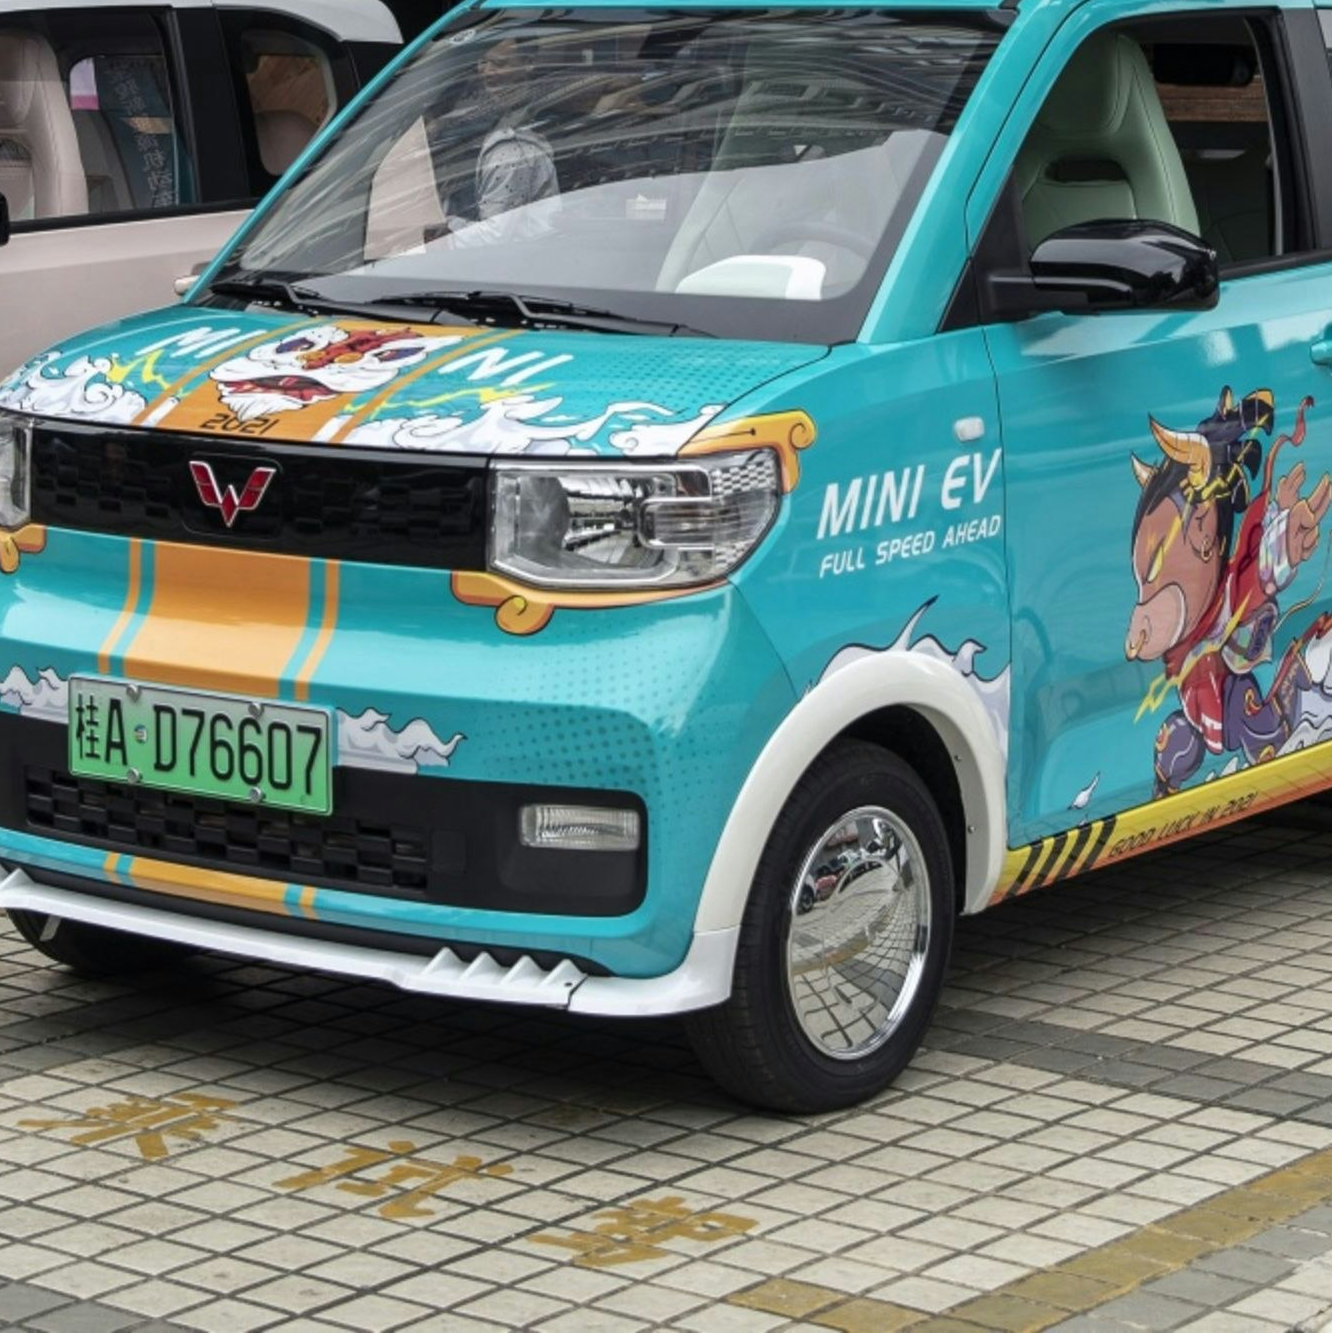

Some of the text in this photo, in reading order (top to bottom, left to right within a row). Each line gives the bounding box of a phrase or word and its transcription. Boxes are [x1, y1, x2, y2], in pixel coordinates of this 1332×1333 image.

[200, 412, 280, 435] 2021
[816, 447, 1003, 540] MINI EV
[819, 514, 1001, 578] FULL SPEED AHEAD
[1108, 828, 1157, 858] GOOD
[1157, 811, 1200, 841] LUCK
[1219, 791, 1259, 818] 2021
